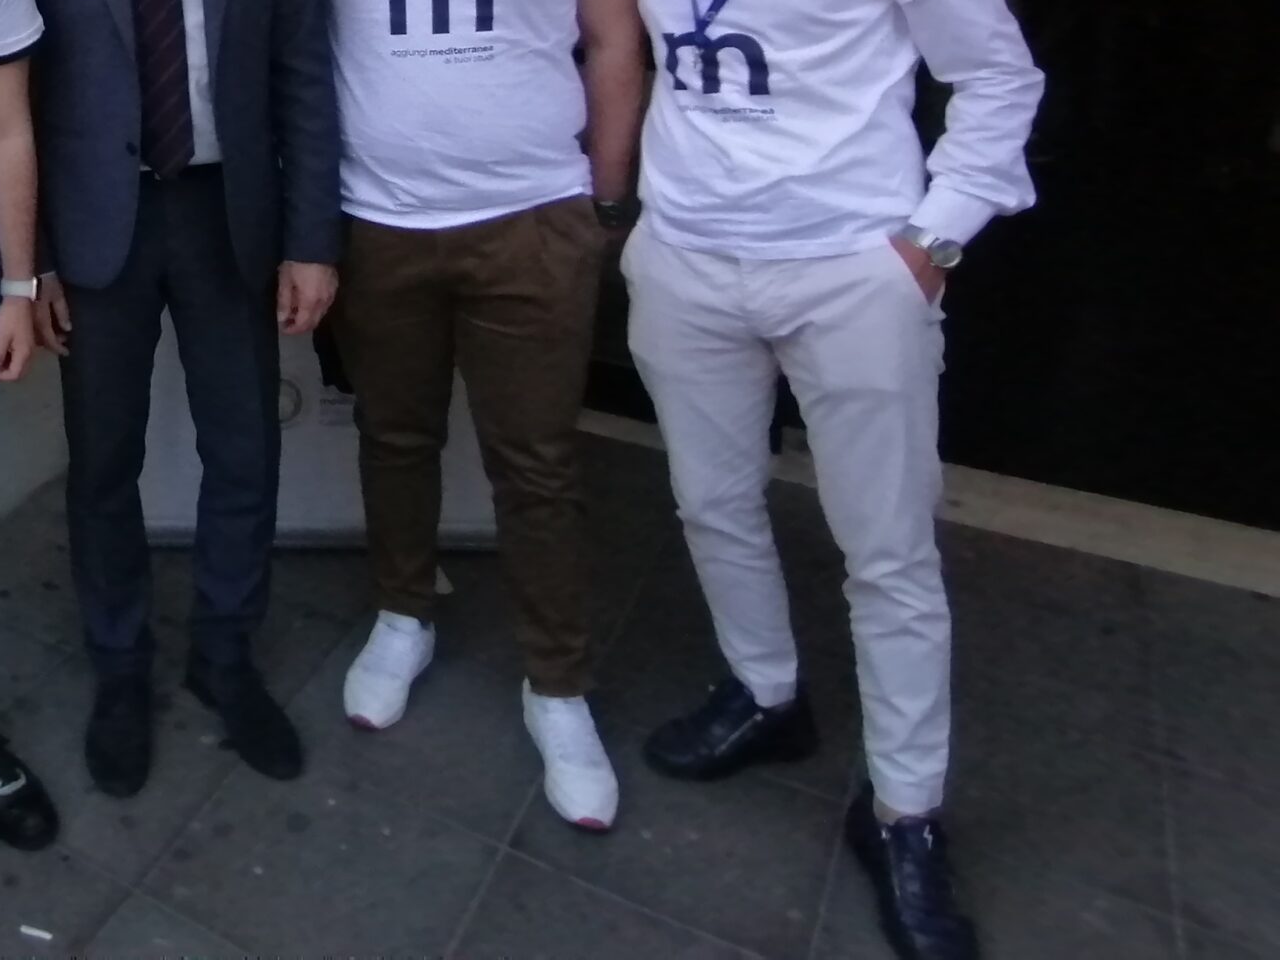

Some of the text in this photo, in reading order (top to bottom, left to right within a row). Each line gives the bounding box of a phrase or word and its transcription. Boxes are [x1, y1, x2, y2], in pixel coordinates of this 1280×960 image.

[390, 45, 494, 58] aggiungi mediterranea
[661, 30, 770, 96] m
